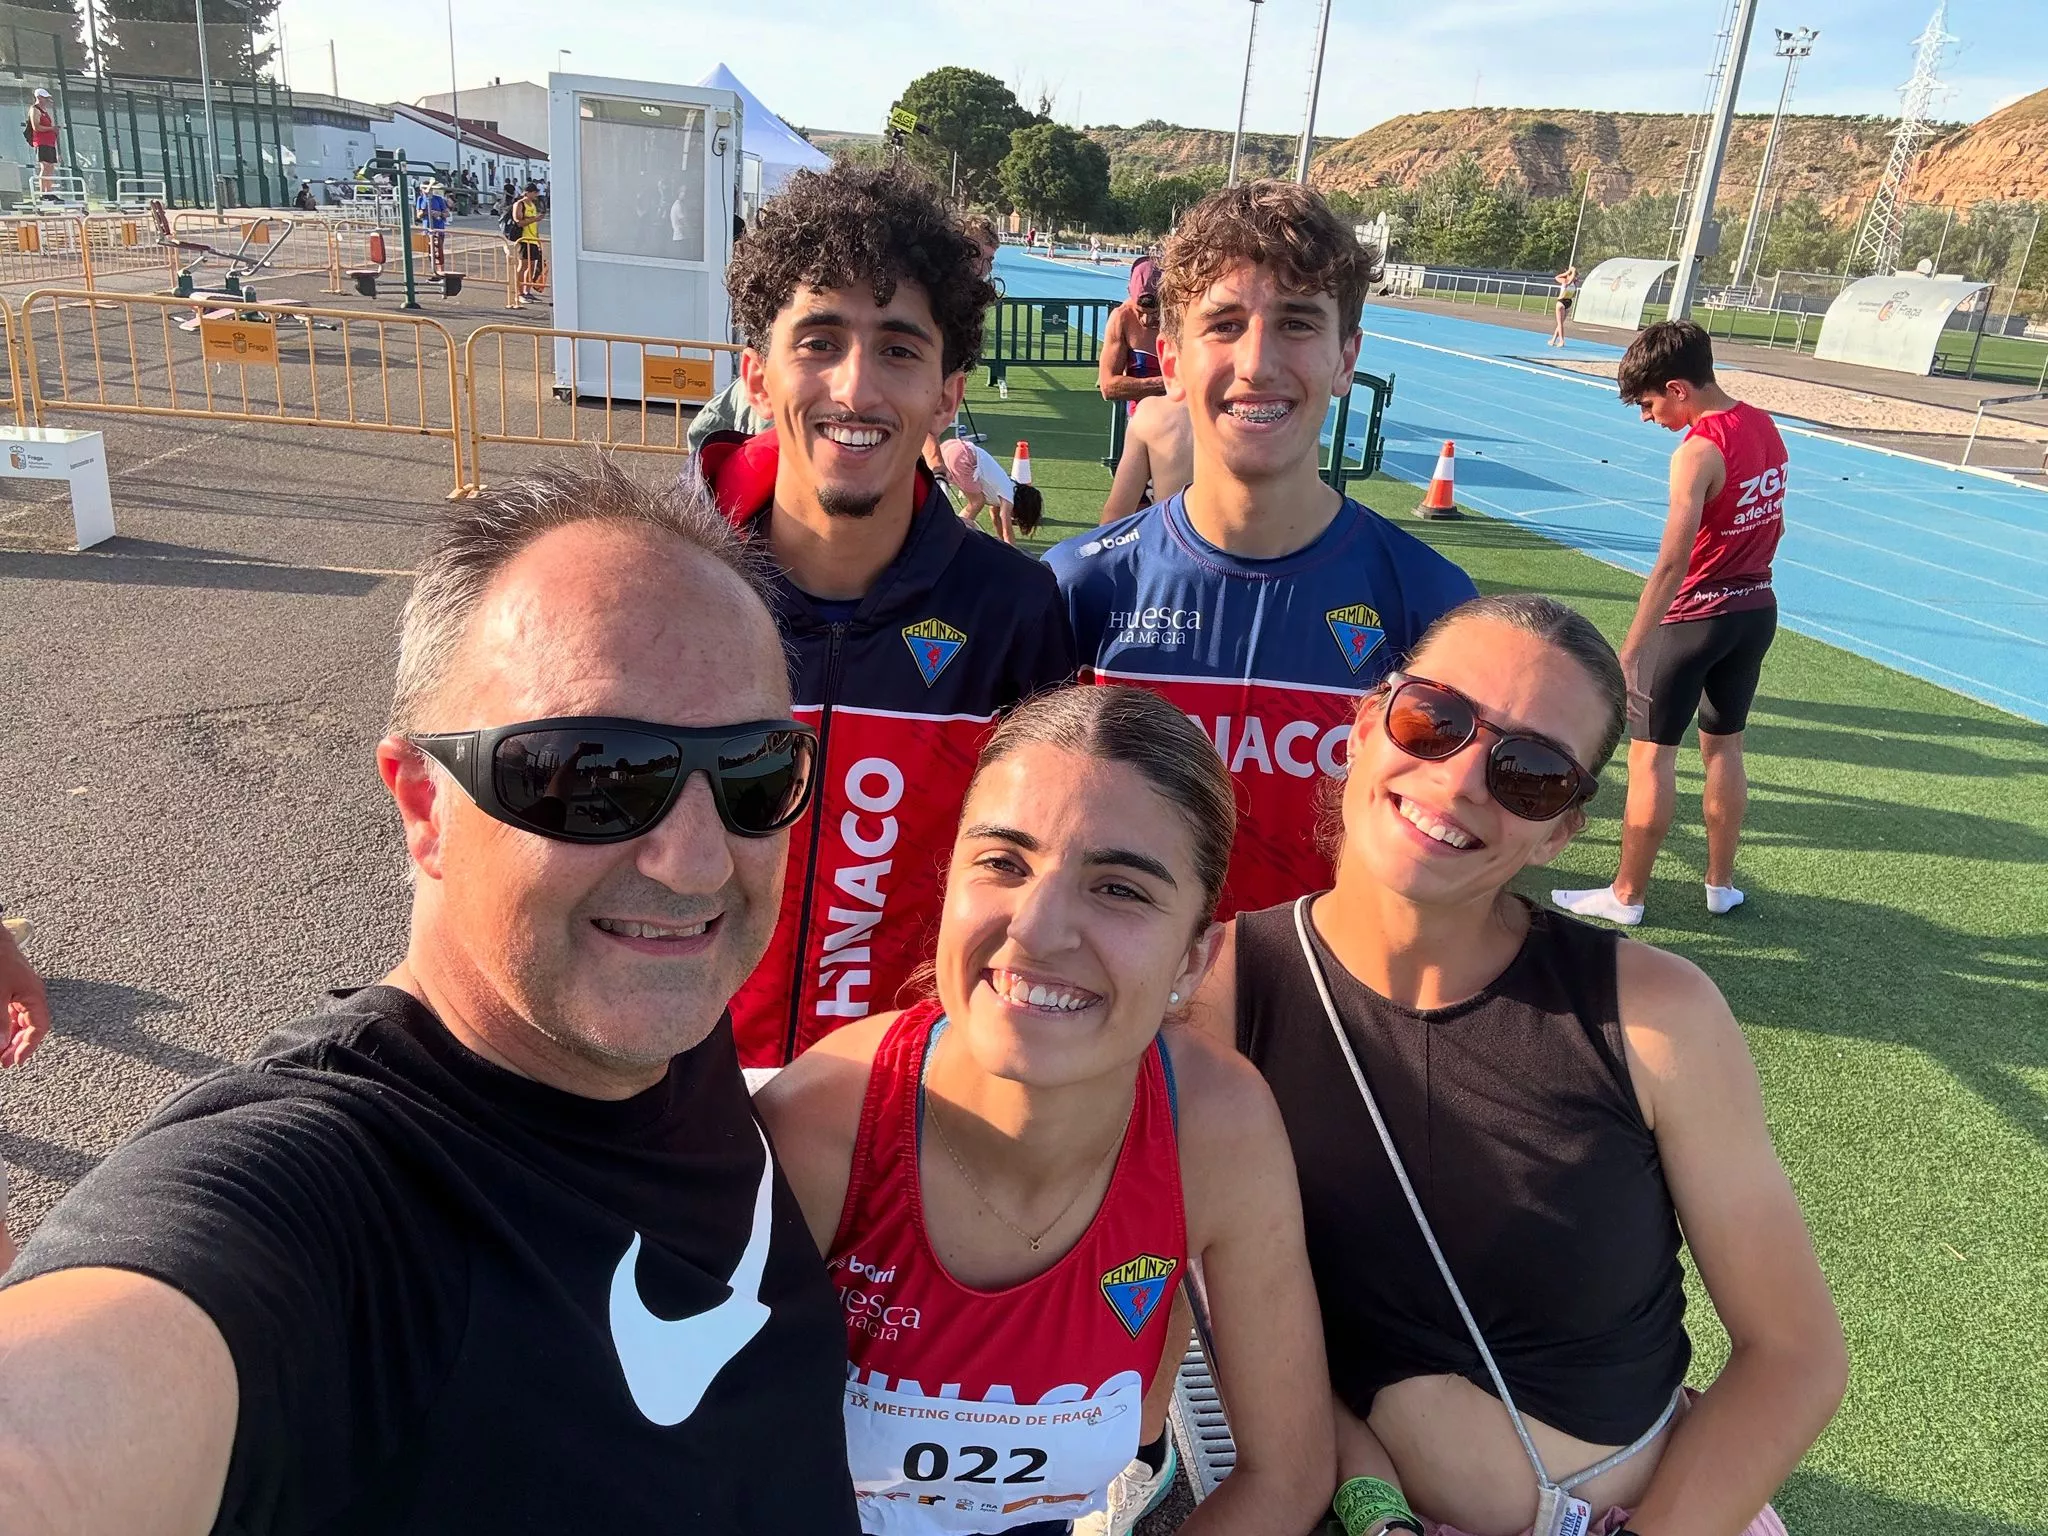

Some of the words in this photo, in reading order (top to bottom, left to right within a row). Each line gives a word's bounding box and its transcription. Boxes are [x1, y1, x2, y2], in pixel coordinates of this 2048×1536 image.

[894, 112, 915, 127] ALGE
[248, 342, 268, 352] Fraga
[850, 1394, 869, 1409] IX
[873, 1401, 949, 1420] MEETING
[954, 1411, 1020, 1426] CIUDAD
[1025, 1414, 1047, 1426] DE
[1052, 1406, 1103, 1425] FRAGA
[903, 1442, 1049, 1485] 022
